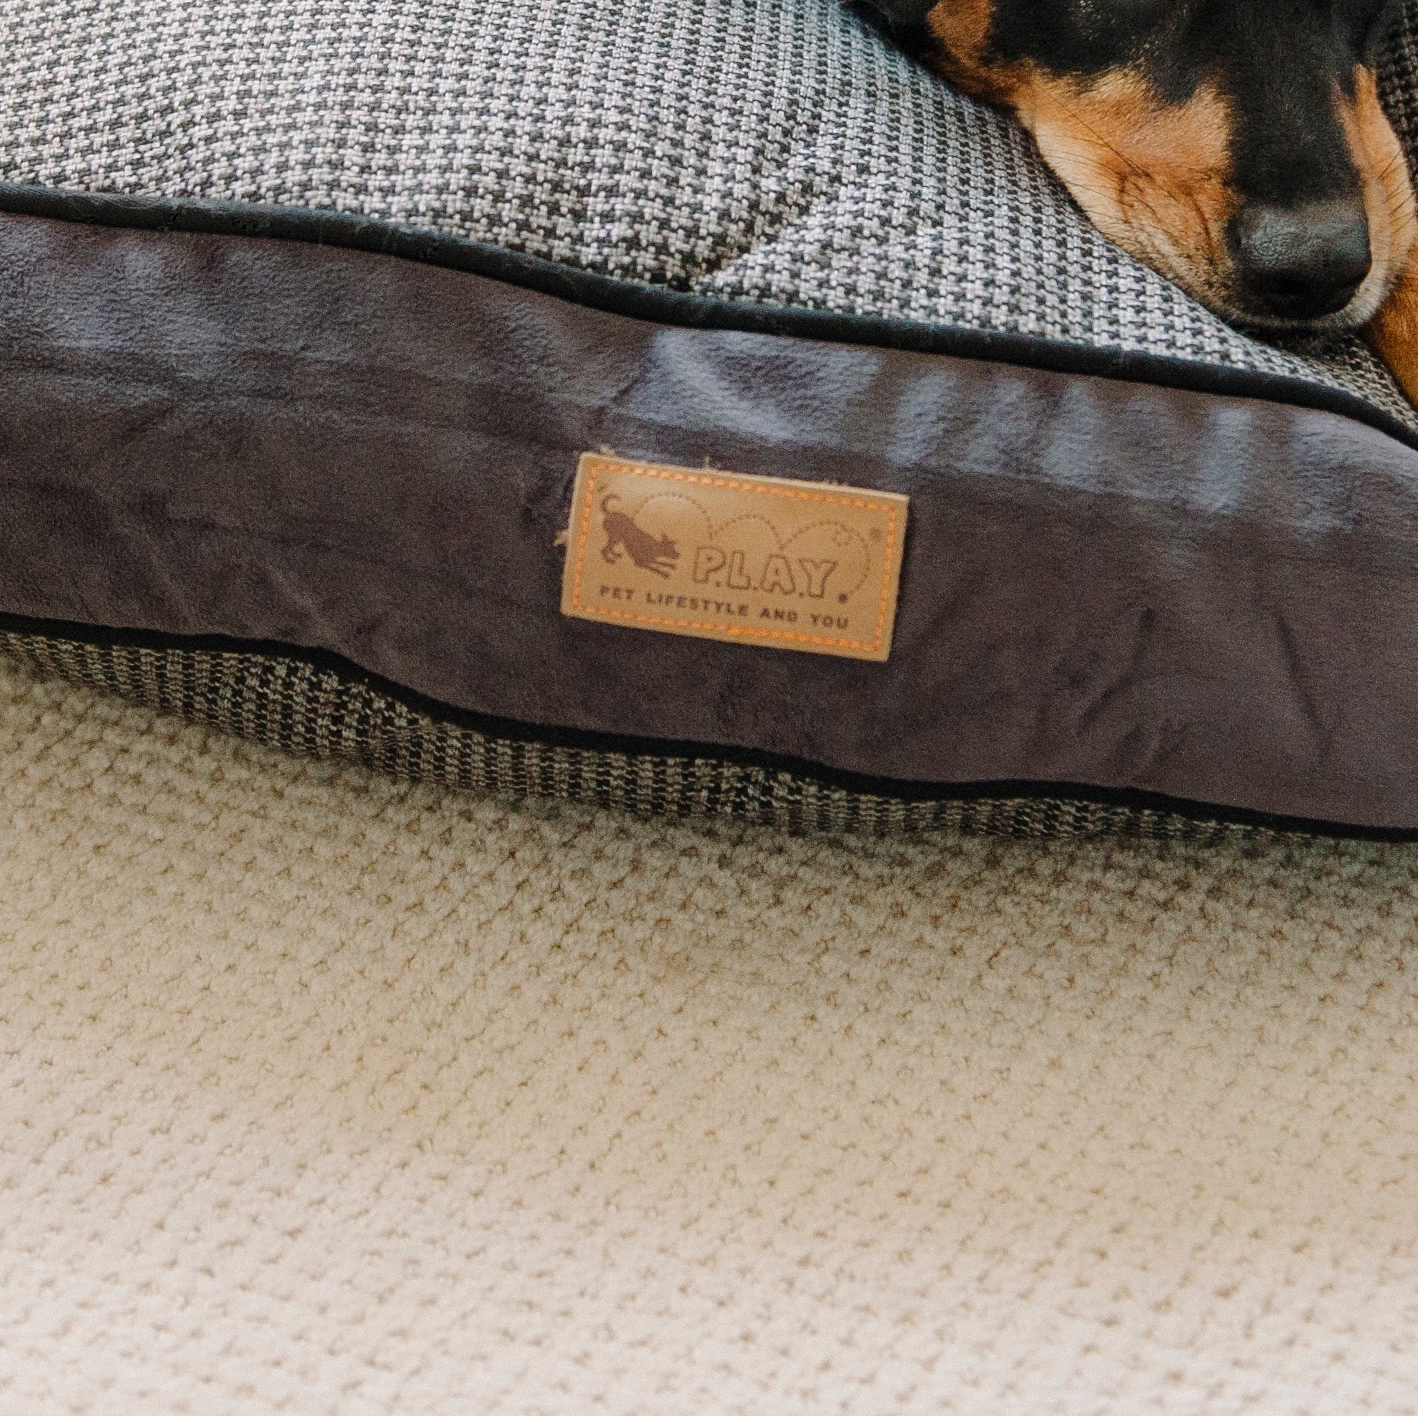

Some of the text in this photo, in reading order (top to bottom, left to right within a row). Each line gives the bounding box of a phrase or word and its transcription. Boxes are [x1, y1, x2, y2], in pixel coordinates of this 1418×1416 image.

[600, 585, 849, 630] PET LIFESTYLE AND YOU
